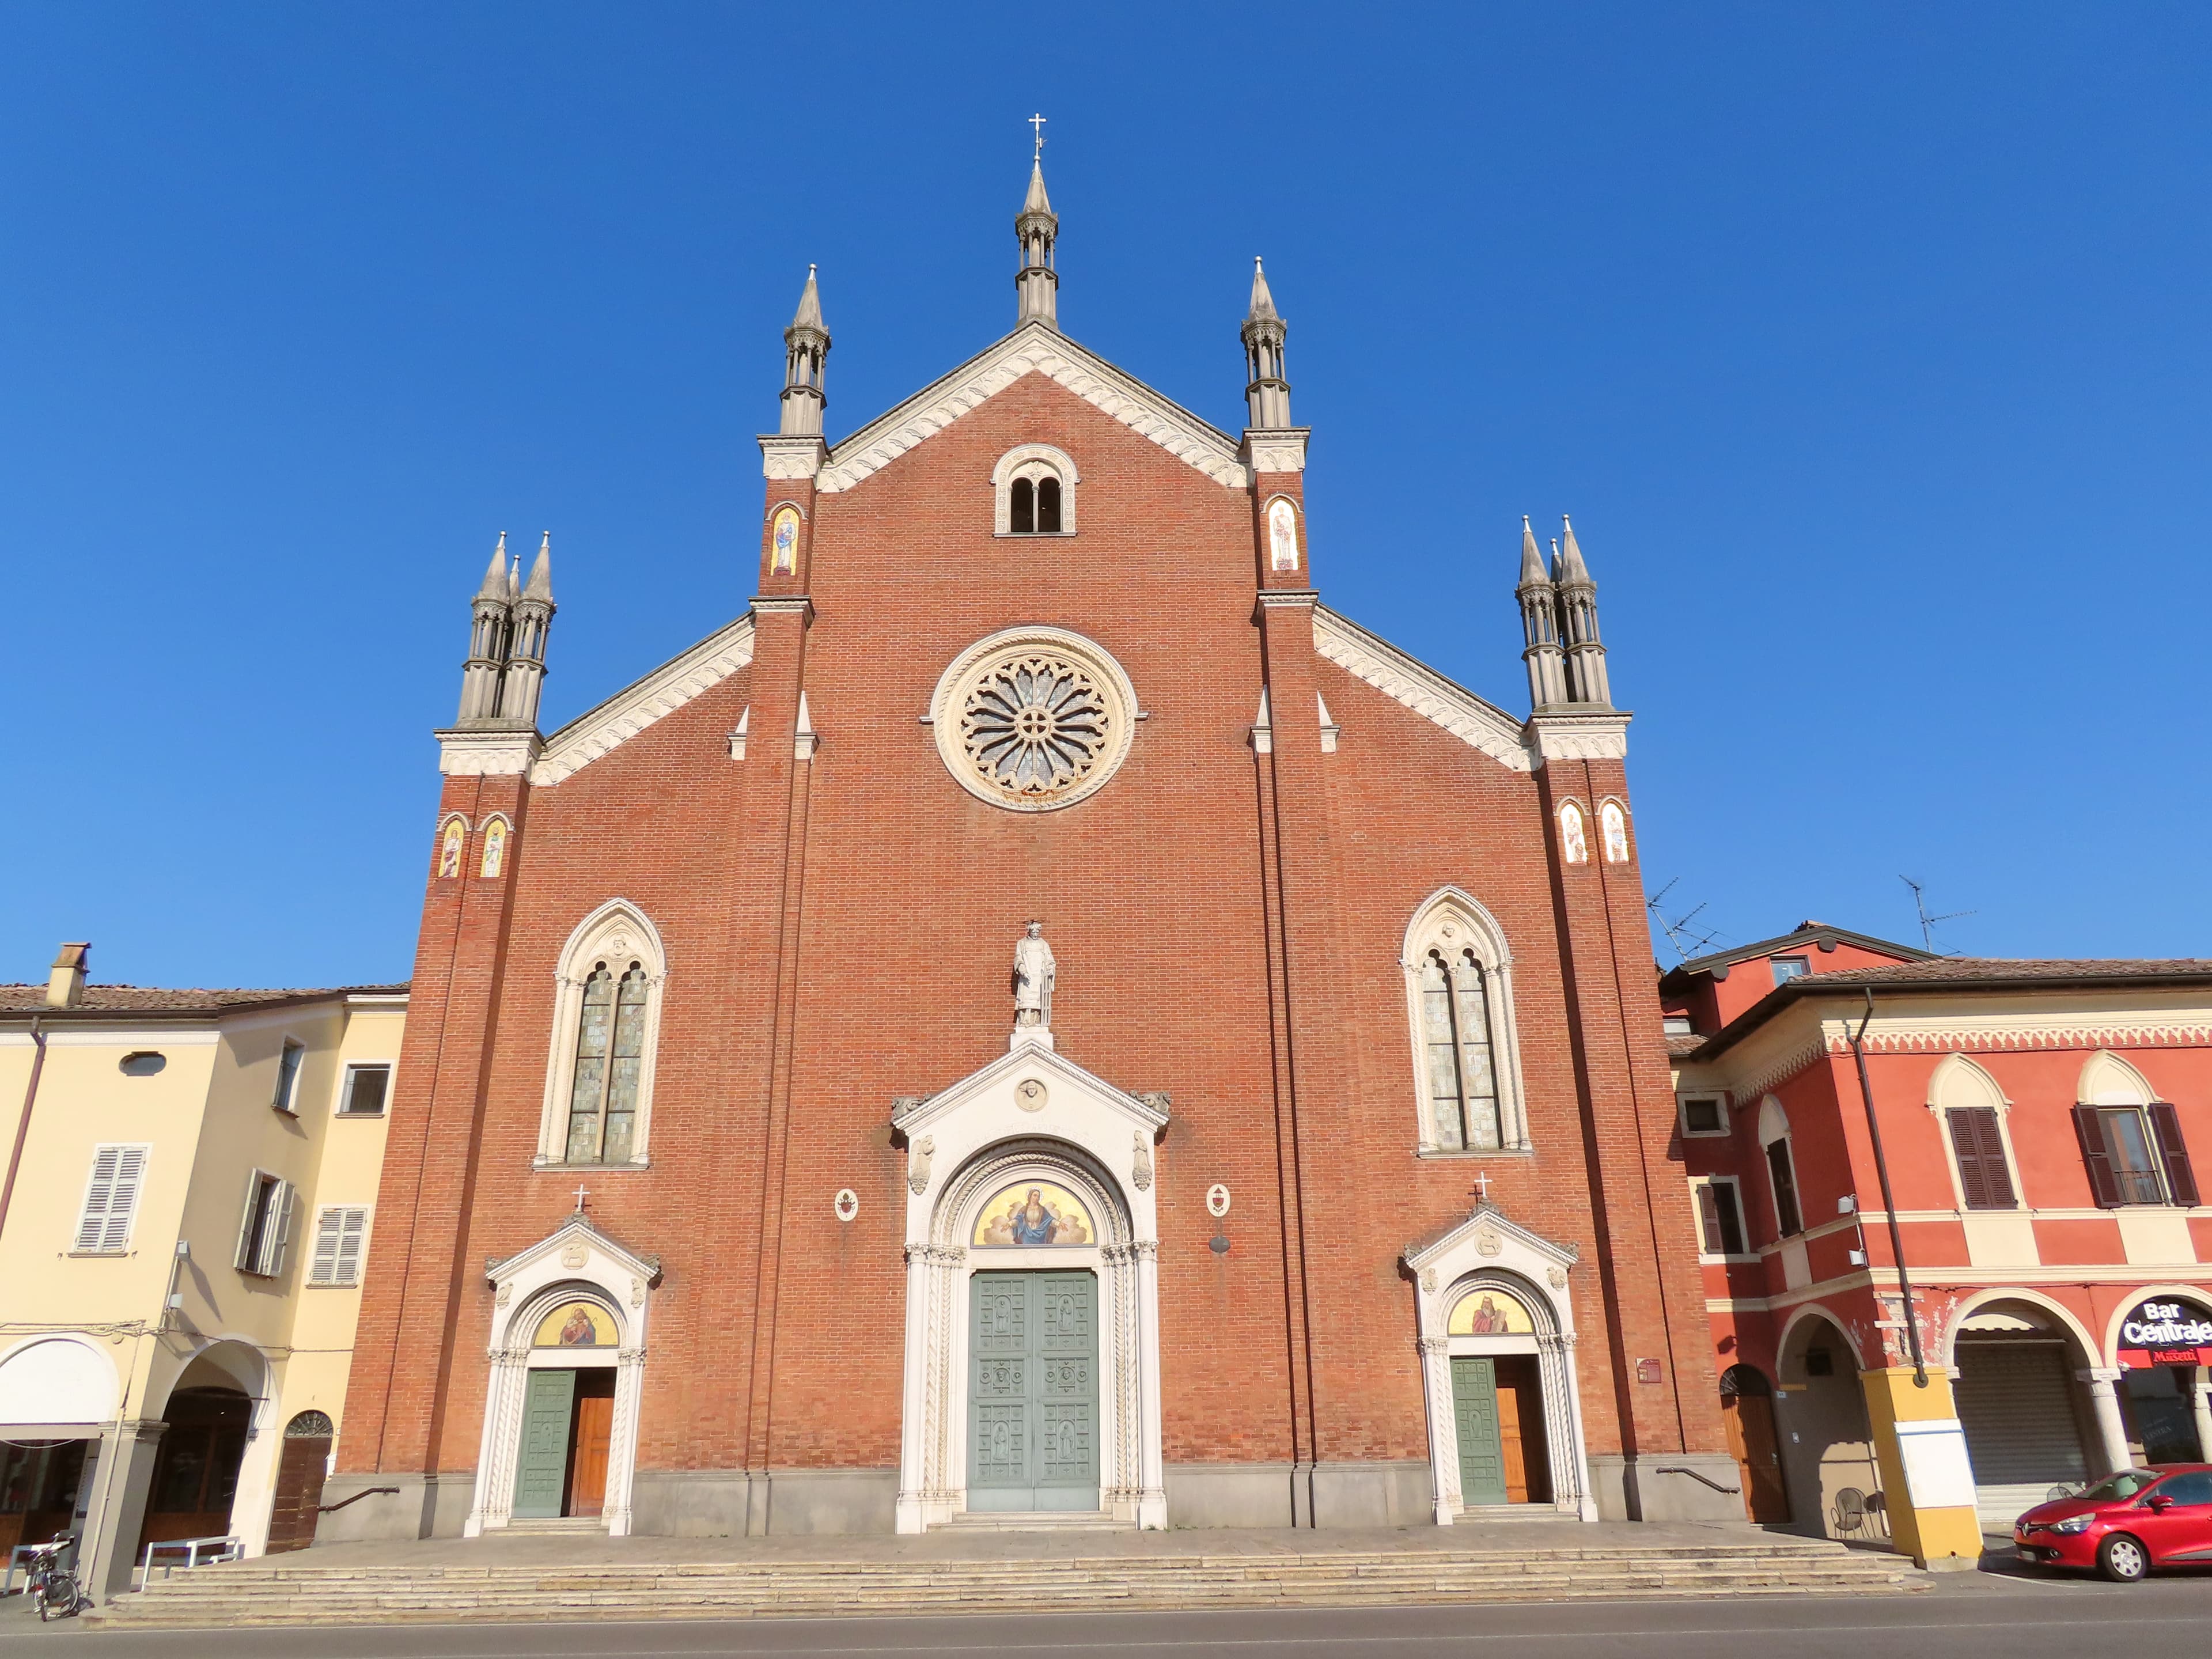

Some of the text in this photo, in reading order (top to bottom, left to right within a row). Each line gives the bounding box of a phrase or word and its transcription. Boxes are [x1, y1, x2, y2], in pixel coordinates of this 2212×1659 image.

[2143, 1303, 2180, 1320] Bar
[2124, 1319, 2212, 1344] Centrale
[2153, 1349, 2197, 1362] Musetti
